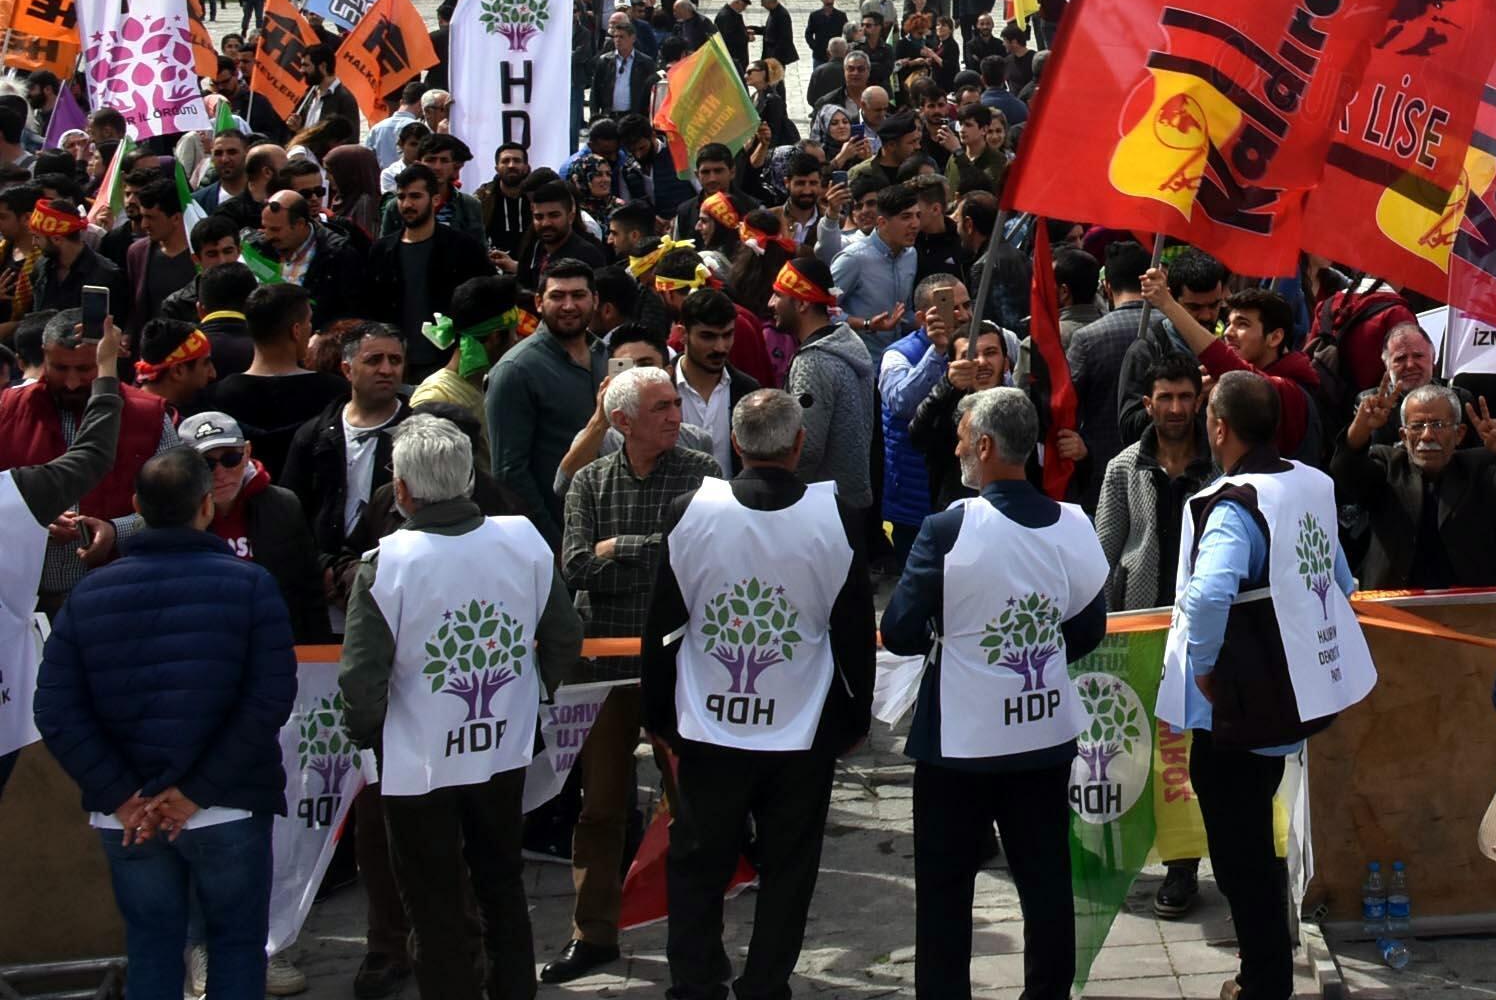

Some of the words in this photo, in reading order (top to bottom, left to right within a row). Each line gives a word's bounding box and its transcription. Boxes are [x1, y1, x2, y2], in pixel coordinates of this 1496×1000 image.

[500, 60, 533, 150] HD
[1362, 74, 1450, 170] LİSE
[1004, 689, 1061, 726] HDP
